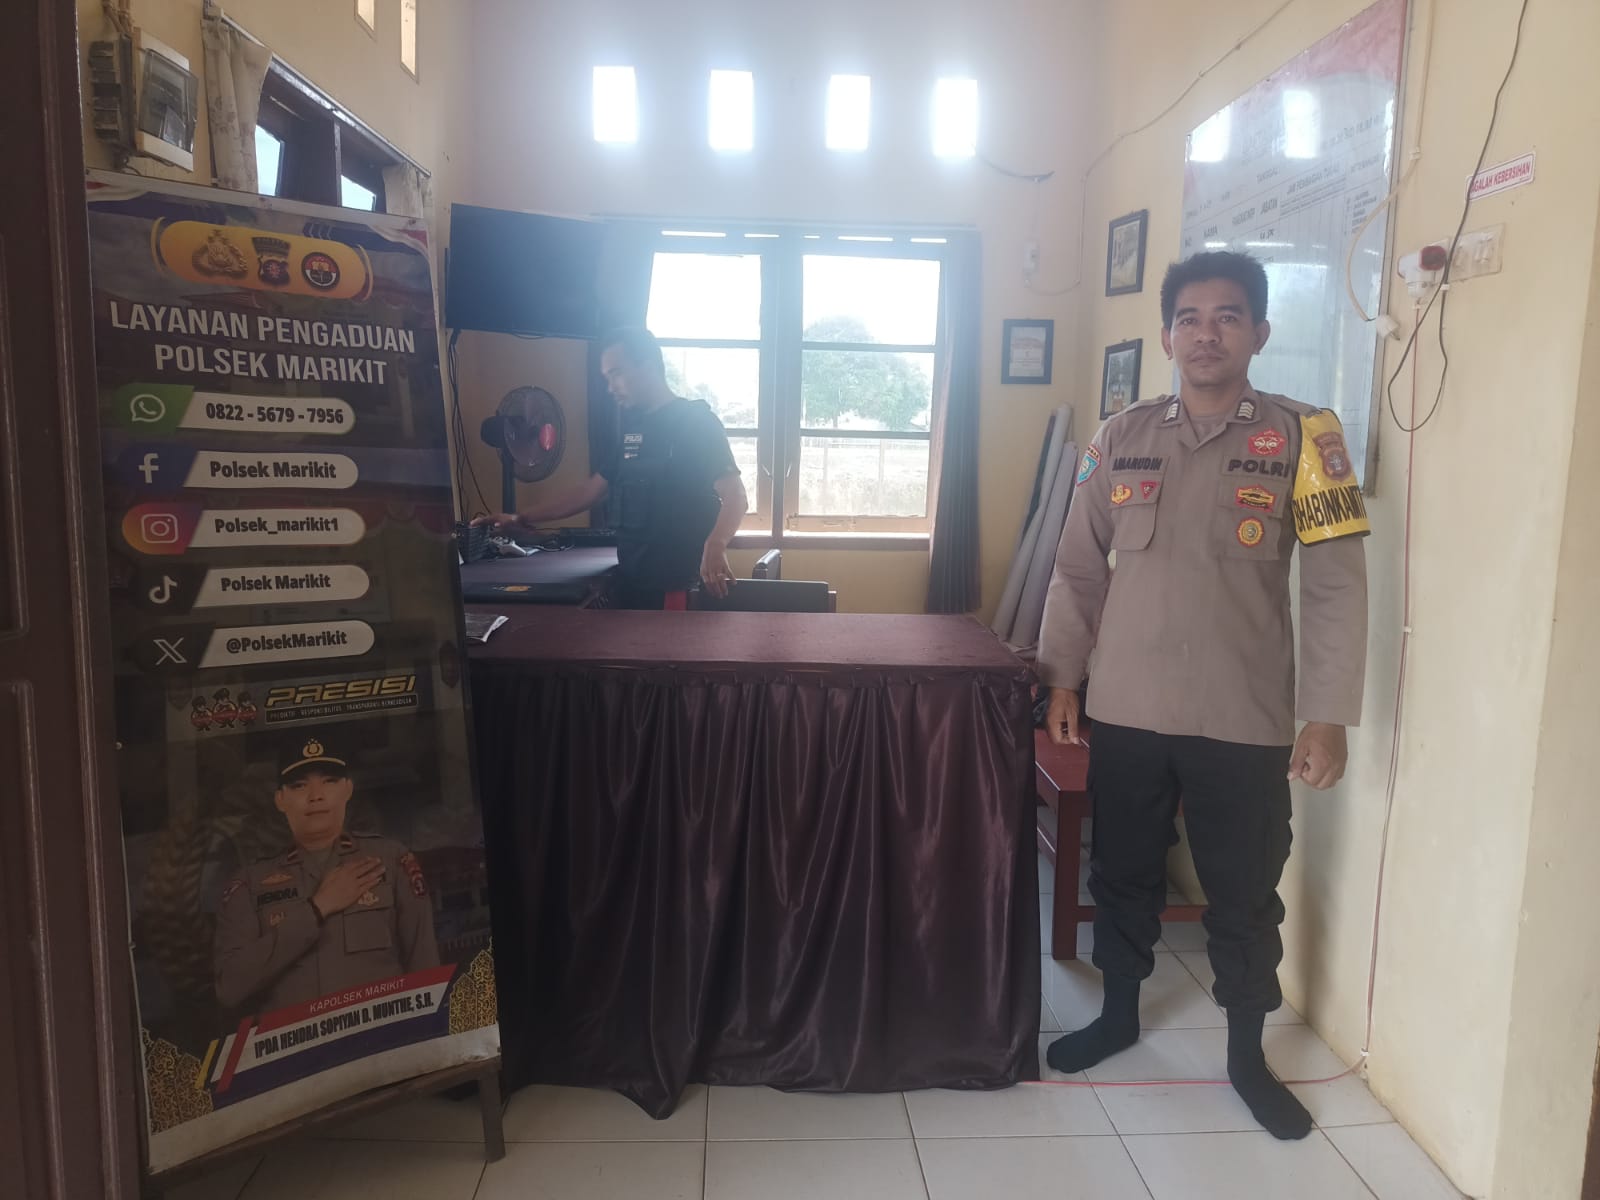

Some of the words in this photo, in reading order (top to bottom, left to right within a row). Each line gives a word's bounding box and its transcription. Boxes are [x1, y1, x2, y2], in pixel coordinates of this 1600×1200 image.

[1494, 161, 1531, 186] KEBERSIHAN
[110, 301, 249, 340] LAYANAN
[257, 316, 415, 353] PENGADUAN
[154, 344, 269, 379] POLSEK
[277, 355, 387, 385] MARIKIT
[206, 403, 244, 422] 0822
[257, 406, 295, 424] 5679
[308, 408, 344, 424] 7956
[210, 461, 270, 478] Polsek
[273, 461, 337, 479] Marikit
[1228, 459, 1290, 478] POLRI
[215, 518, 339, 534] Polsek_marikit1
[221, 575, 272, 592] Polsek
[275, 573, 331, 590] Marikit
[226, 631, 348, 653] @PolsekMarikit
[265, 675, 417, 707] PRESISI
[310, 990, 362, 1013] KAPOLSEK
[365, 979, 405, 996] MARIKIT
[254, 1035, 279, 1059] IPDA
[280, 1024, 319, 1050] HENDRA
[320, 1009, 361, 1037] SOPIYAN
[373, 996, 415, 1020] MUNTHE,
